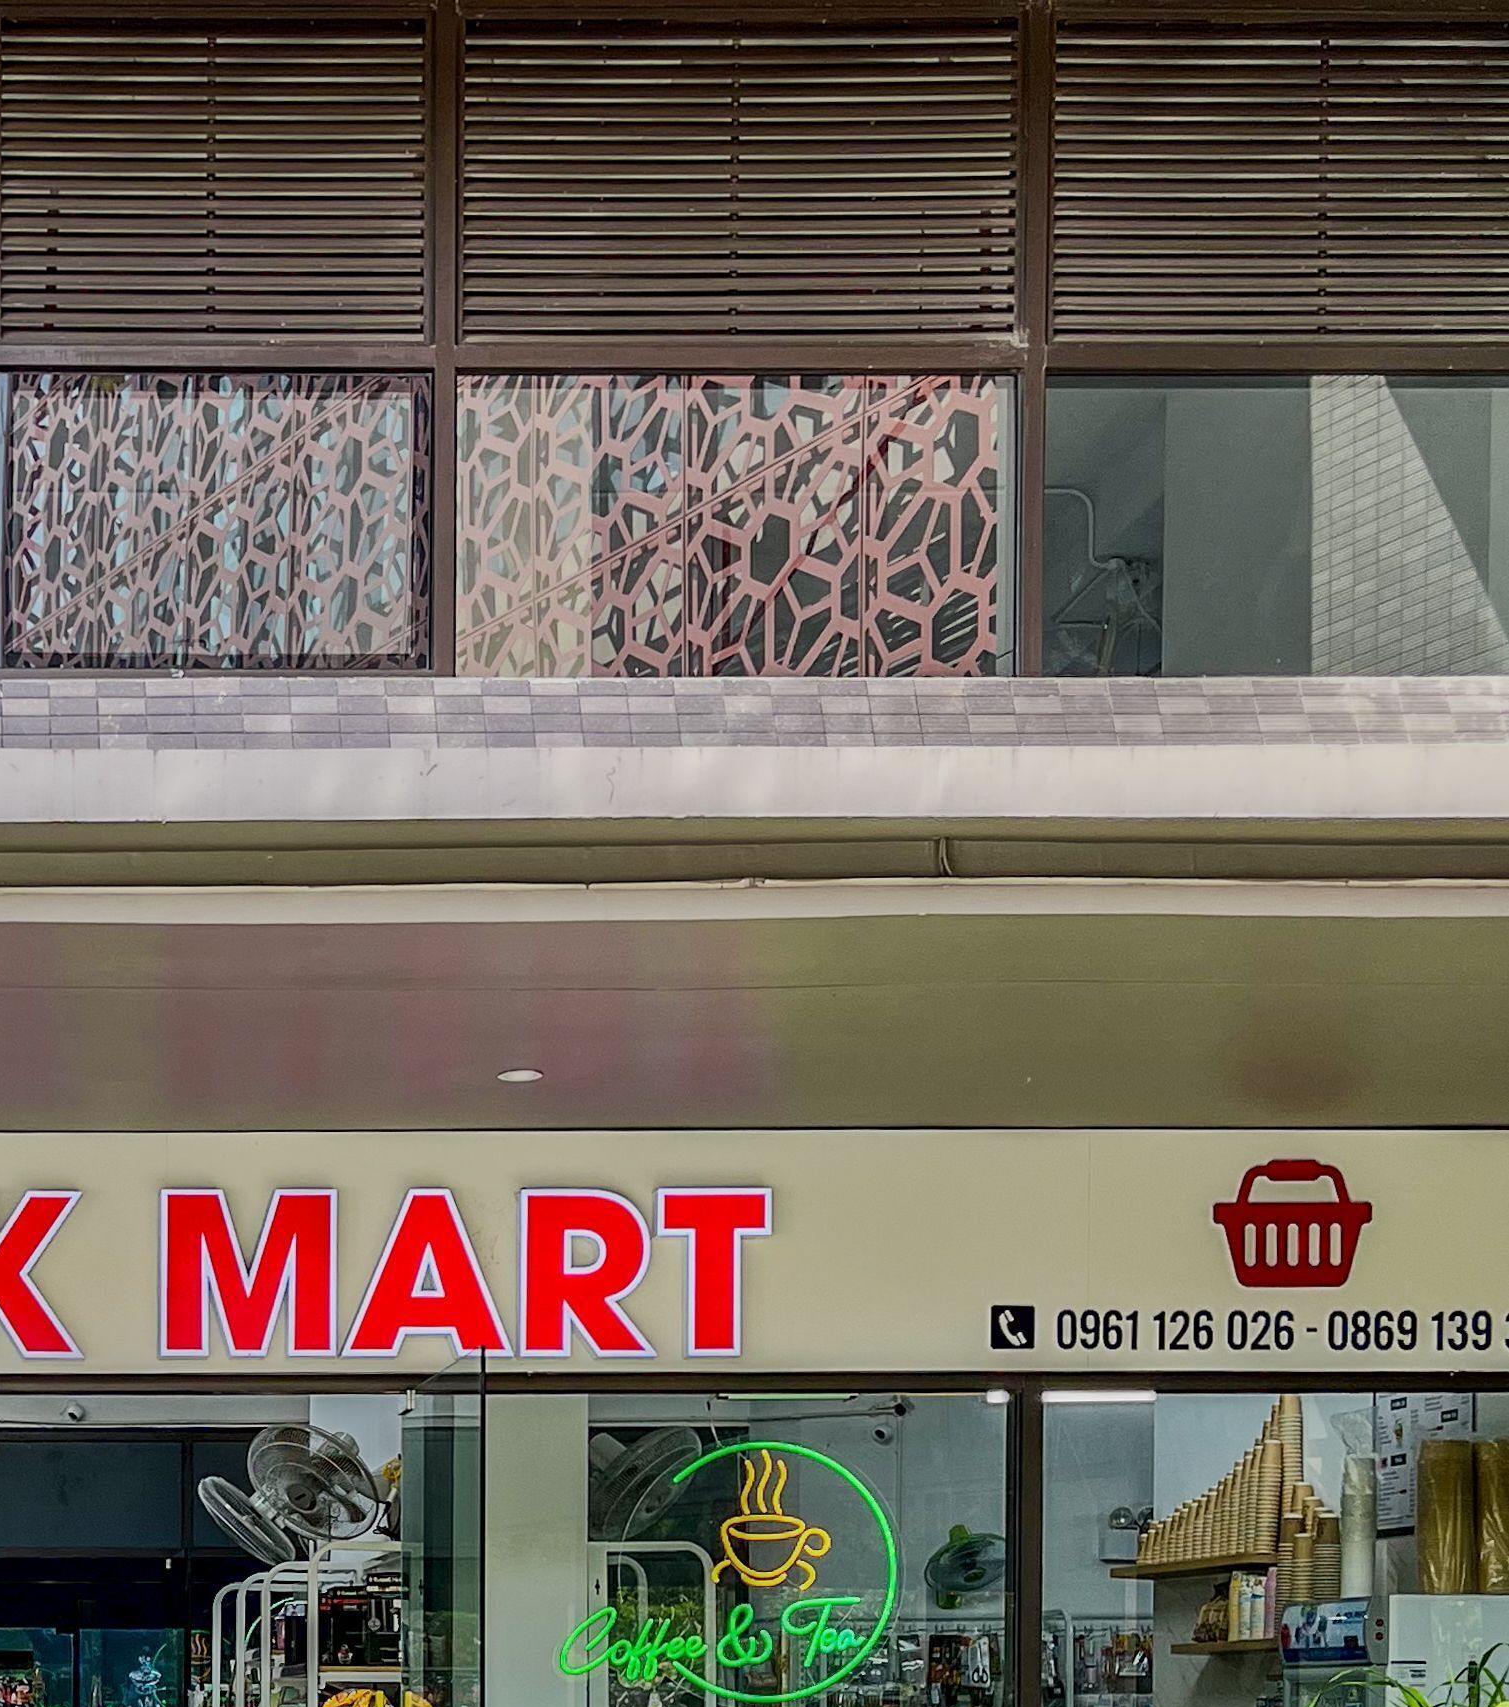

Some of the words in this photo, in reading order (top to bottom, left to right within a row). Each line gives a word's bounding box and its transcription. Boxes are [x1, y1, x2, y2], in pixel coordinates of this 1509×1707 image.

[159, 1187, 774, 1358] MART
[1057, 1310, 1139, 1350] 0961
[1153, 1310, 1214, 1350] 126
[1227, 1310, 1294, 1350] 026
[1328, 1310, 1418, 1351] 0869
[1431, 1310, 1492, 1351] 139
[560, 1606, 707, 1681] Coffee
[717, 1604, 773, 1667] &
[782, 1597, 866, 1667] Tea
